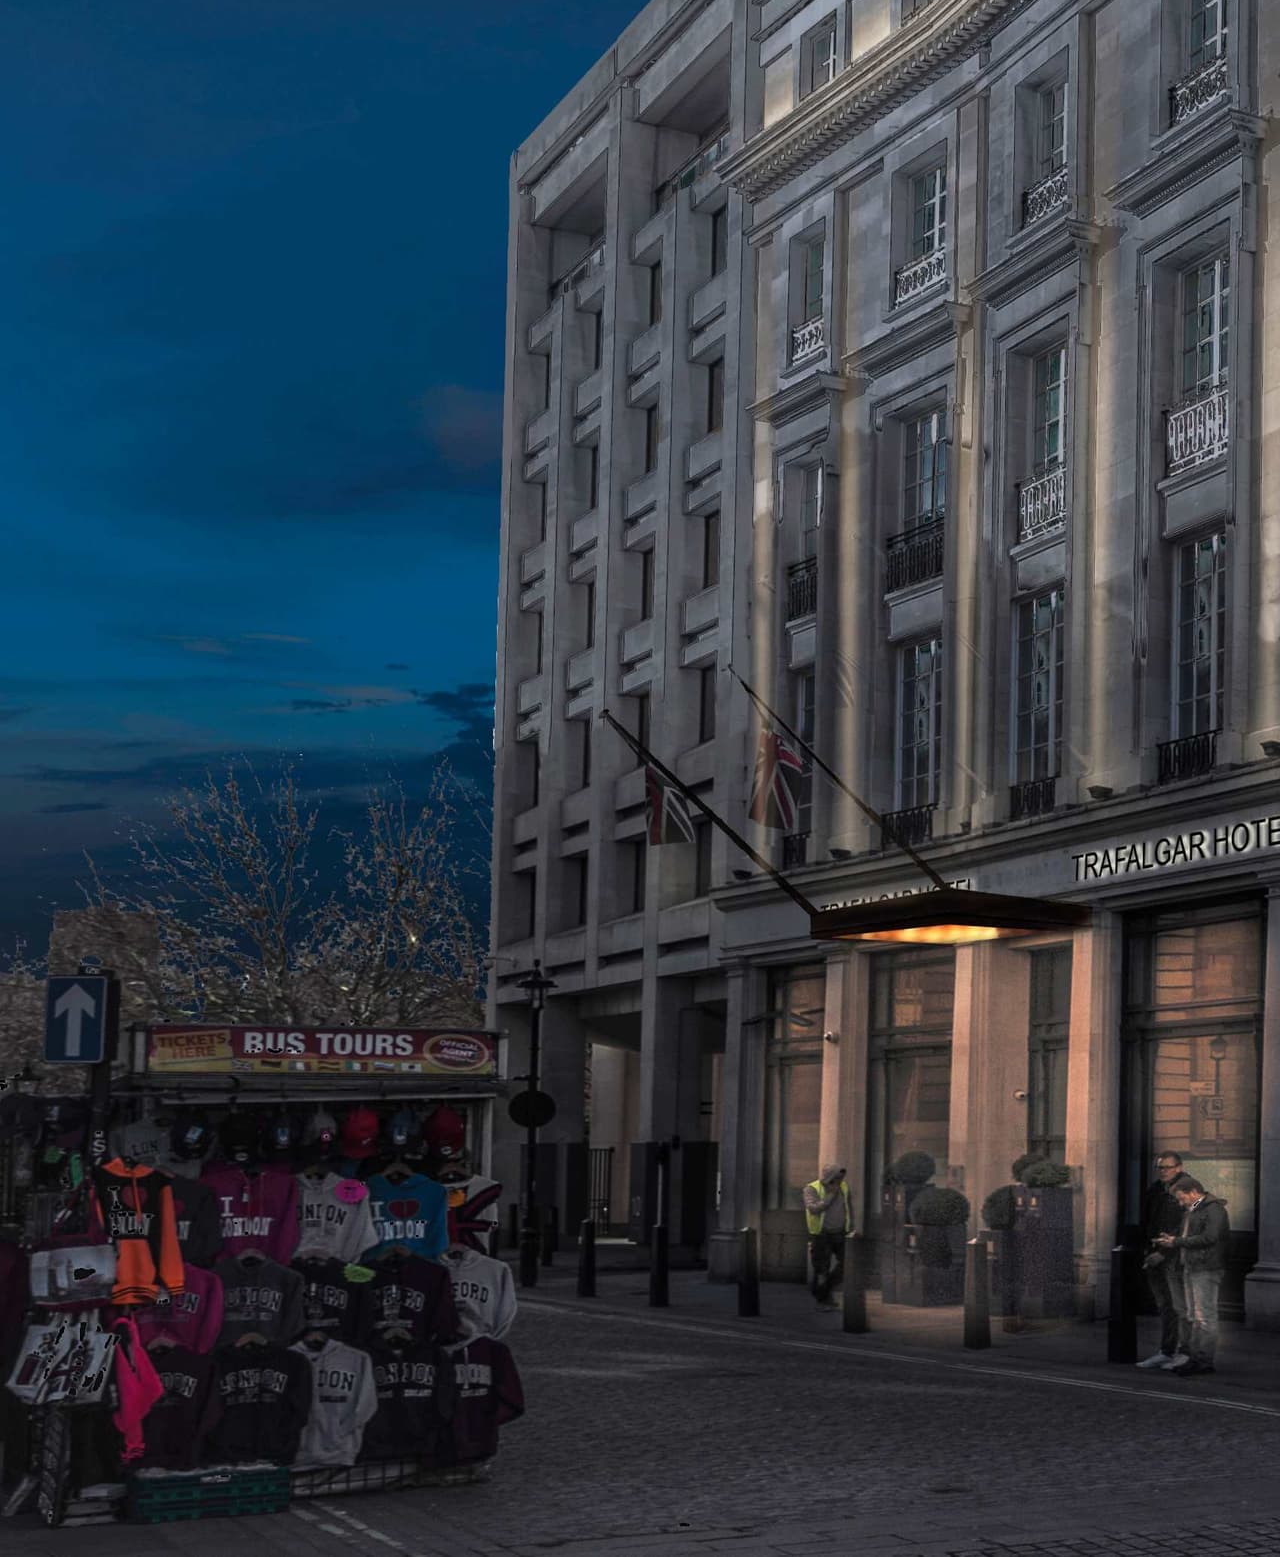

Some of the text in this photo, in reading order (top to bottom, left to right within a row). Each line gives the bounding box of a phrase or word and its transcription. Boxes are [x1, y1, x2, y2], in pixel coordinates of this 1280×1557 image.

[1072, 831, 1205, 881] TRAFALGAR
[157, 1033, 226, 1048] TICKETS
[243, 1031, 414, 1056] BUS TOURS
[172, 1046, 217, 1059] HERE
